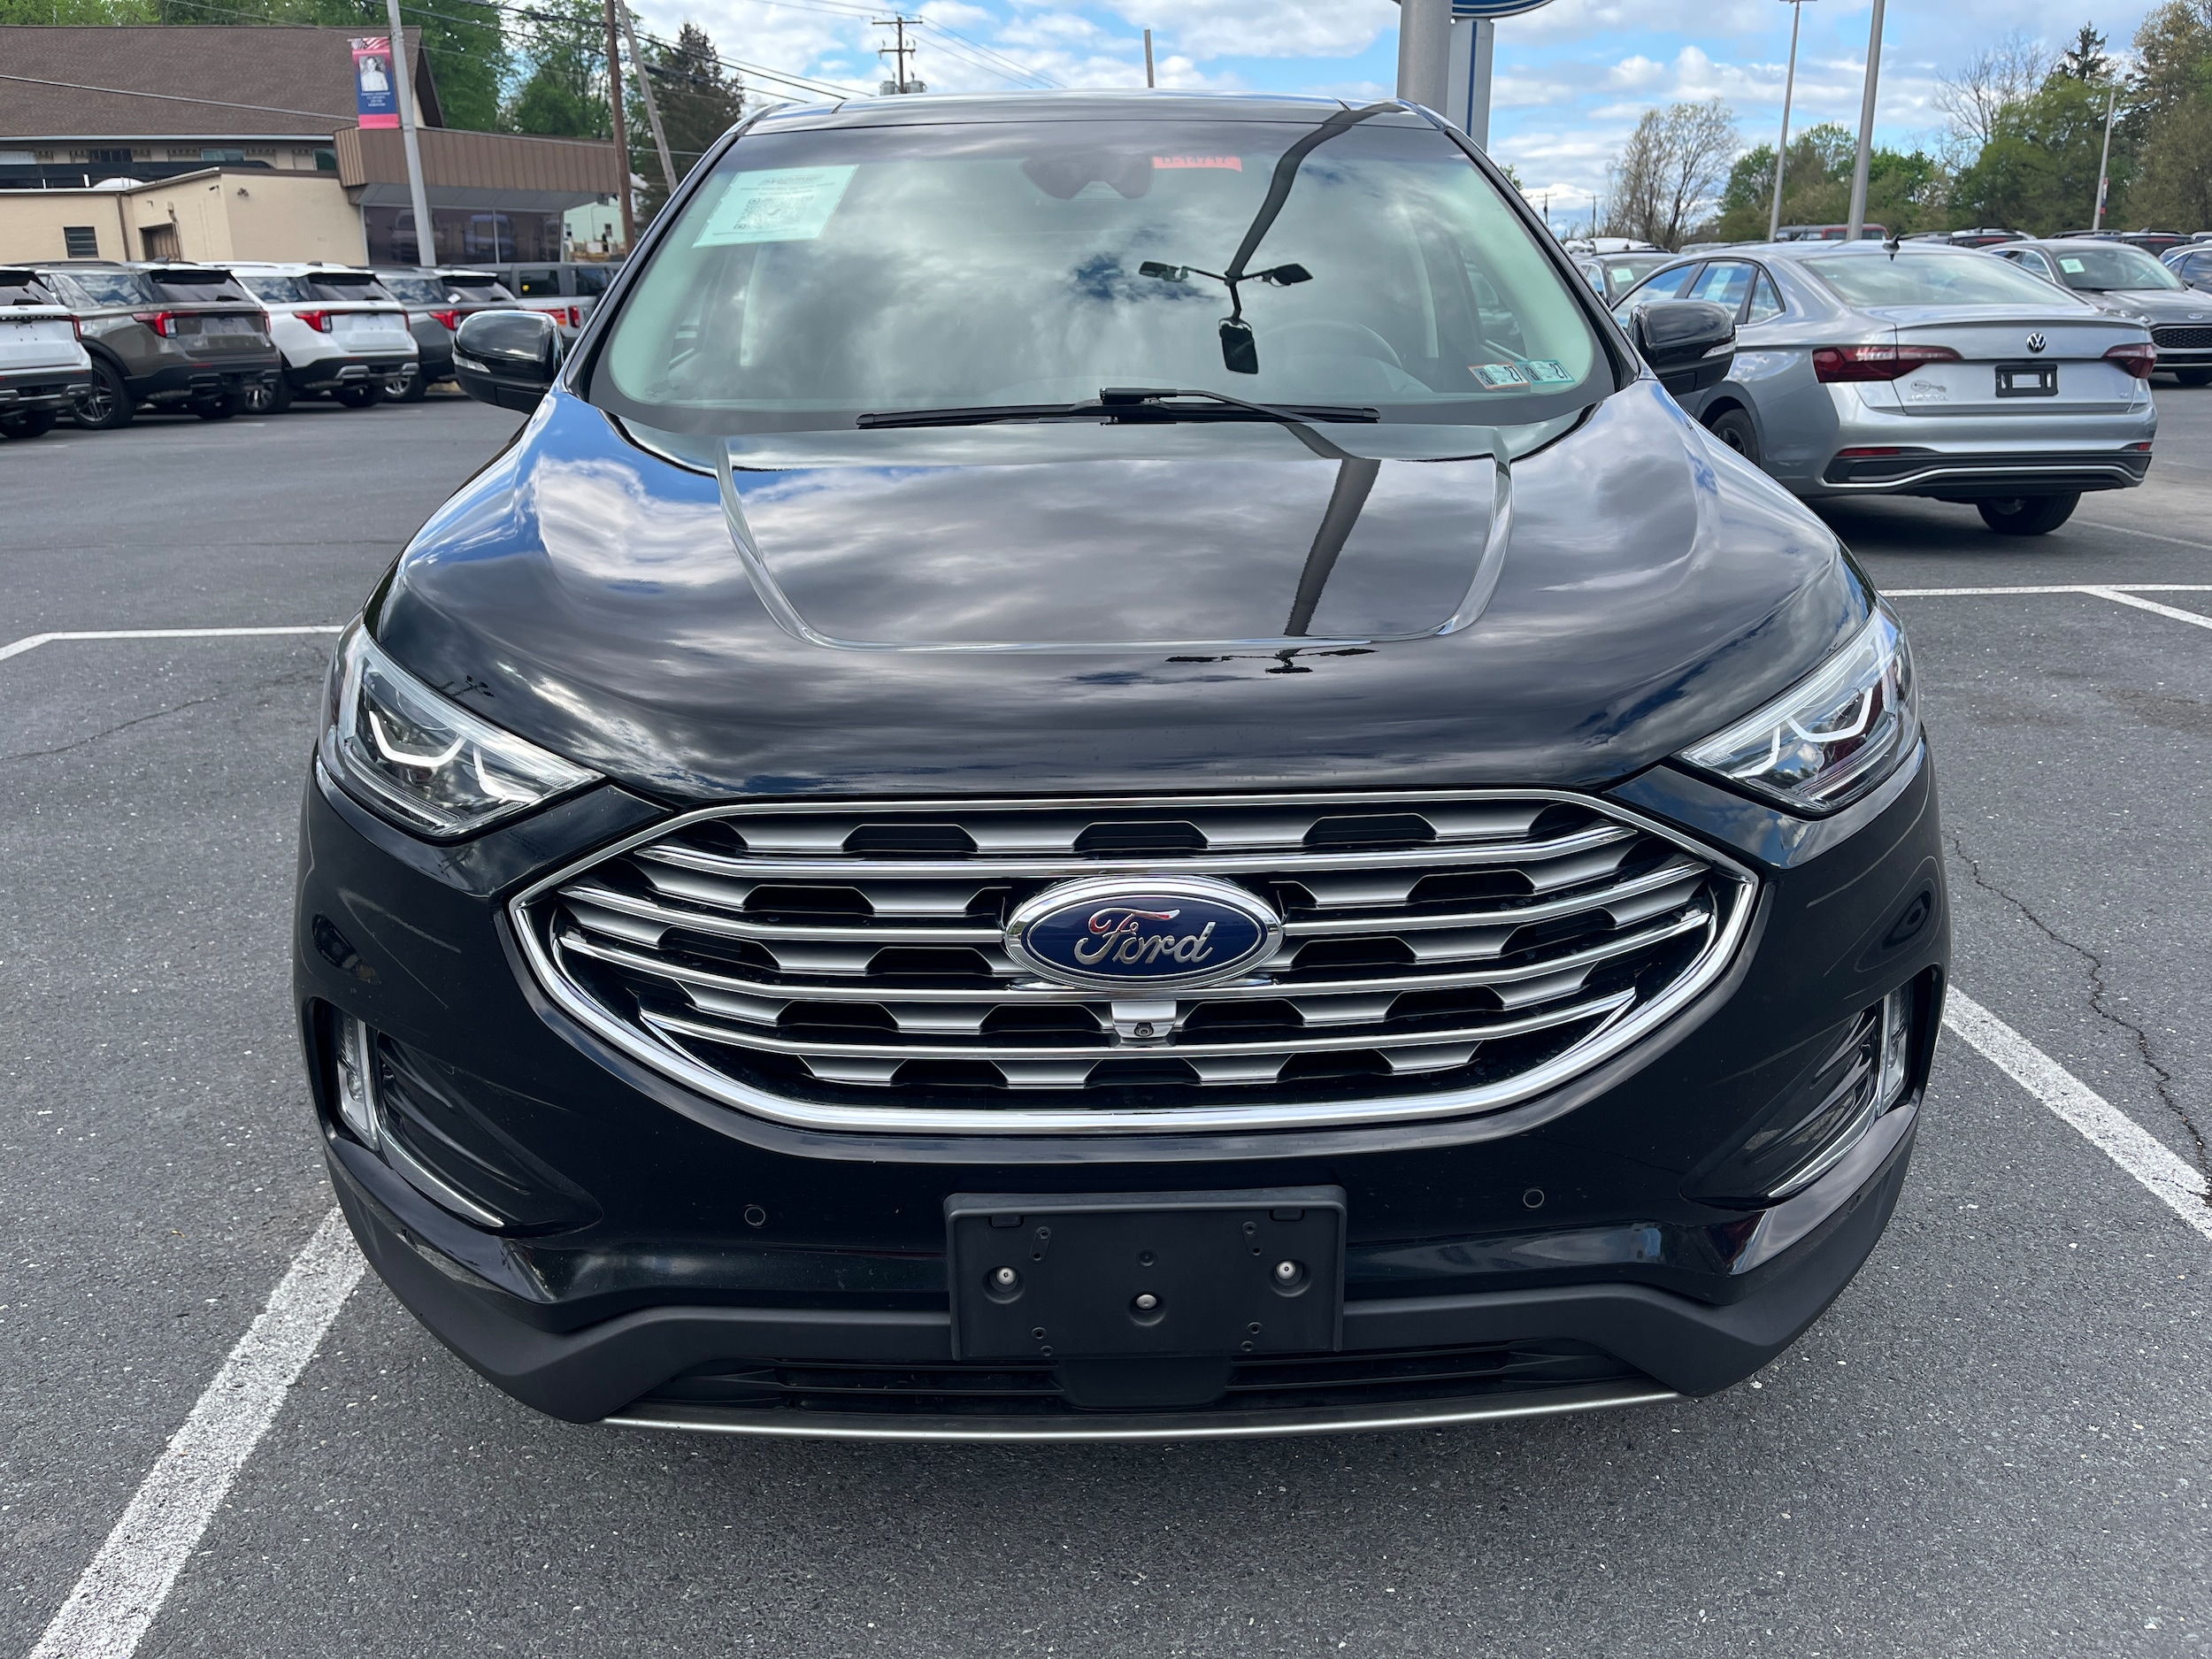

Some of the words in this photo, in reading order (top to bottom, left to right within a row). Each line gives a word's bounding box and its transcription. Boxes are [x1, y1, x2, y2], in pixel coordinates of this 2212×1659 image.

[1503, 365, 1524, 383] 27
[1548, 362, 1569, 380] 27
[1073, 907, 1217, 964] Ford
